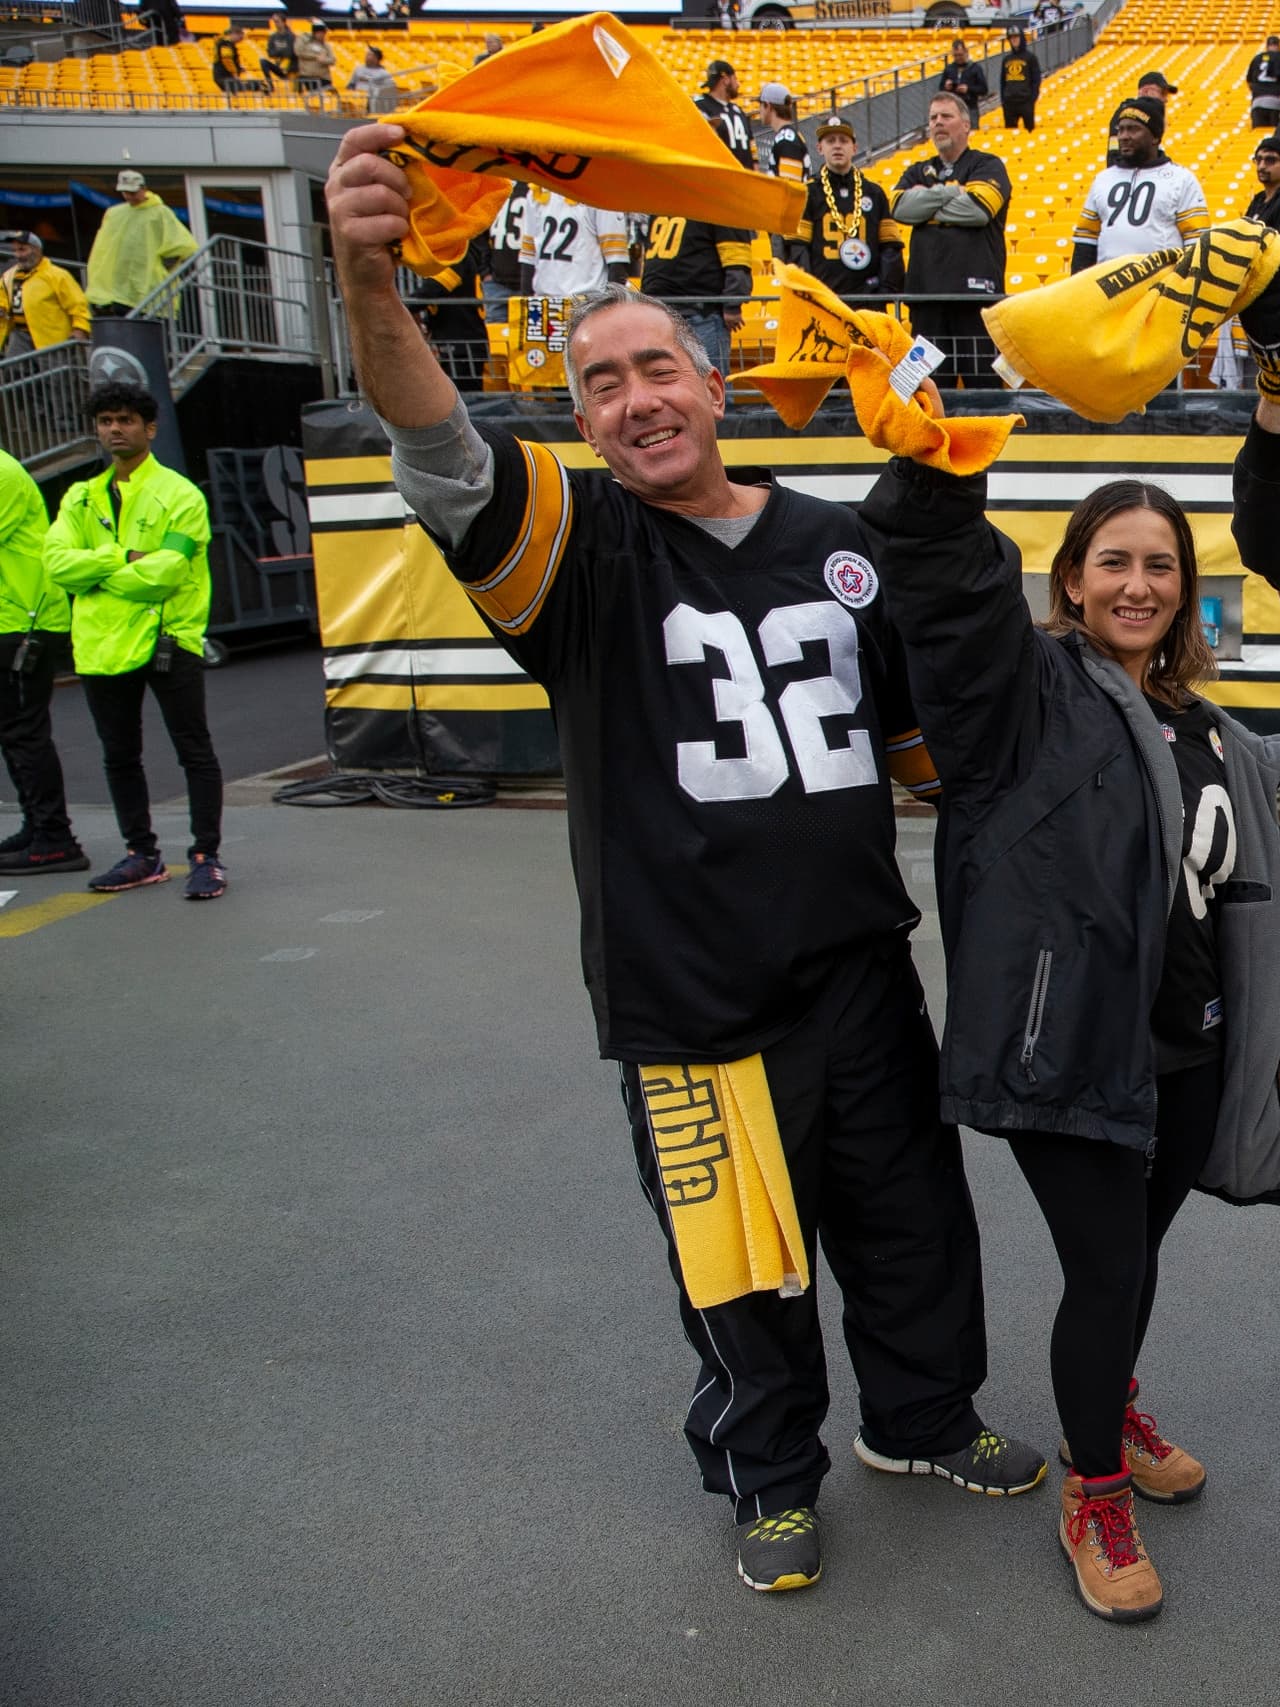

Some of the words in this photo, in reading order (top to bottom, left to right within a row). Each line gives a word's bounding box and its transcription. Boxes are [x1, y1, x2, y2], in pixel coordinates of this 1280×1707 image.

[815, 0, 892, 19] Steelers
[1107, 181, 1156, 227] 90
[539, 215, 579, 262] 22
[647, 216, 686, 260] 90
[662, 600, 879, 803] 32
